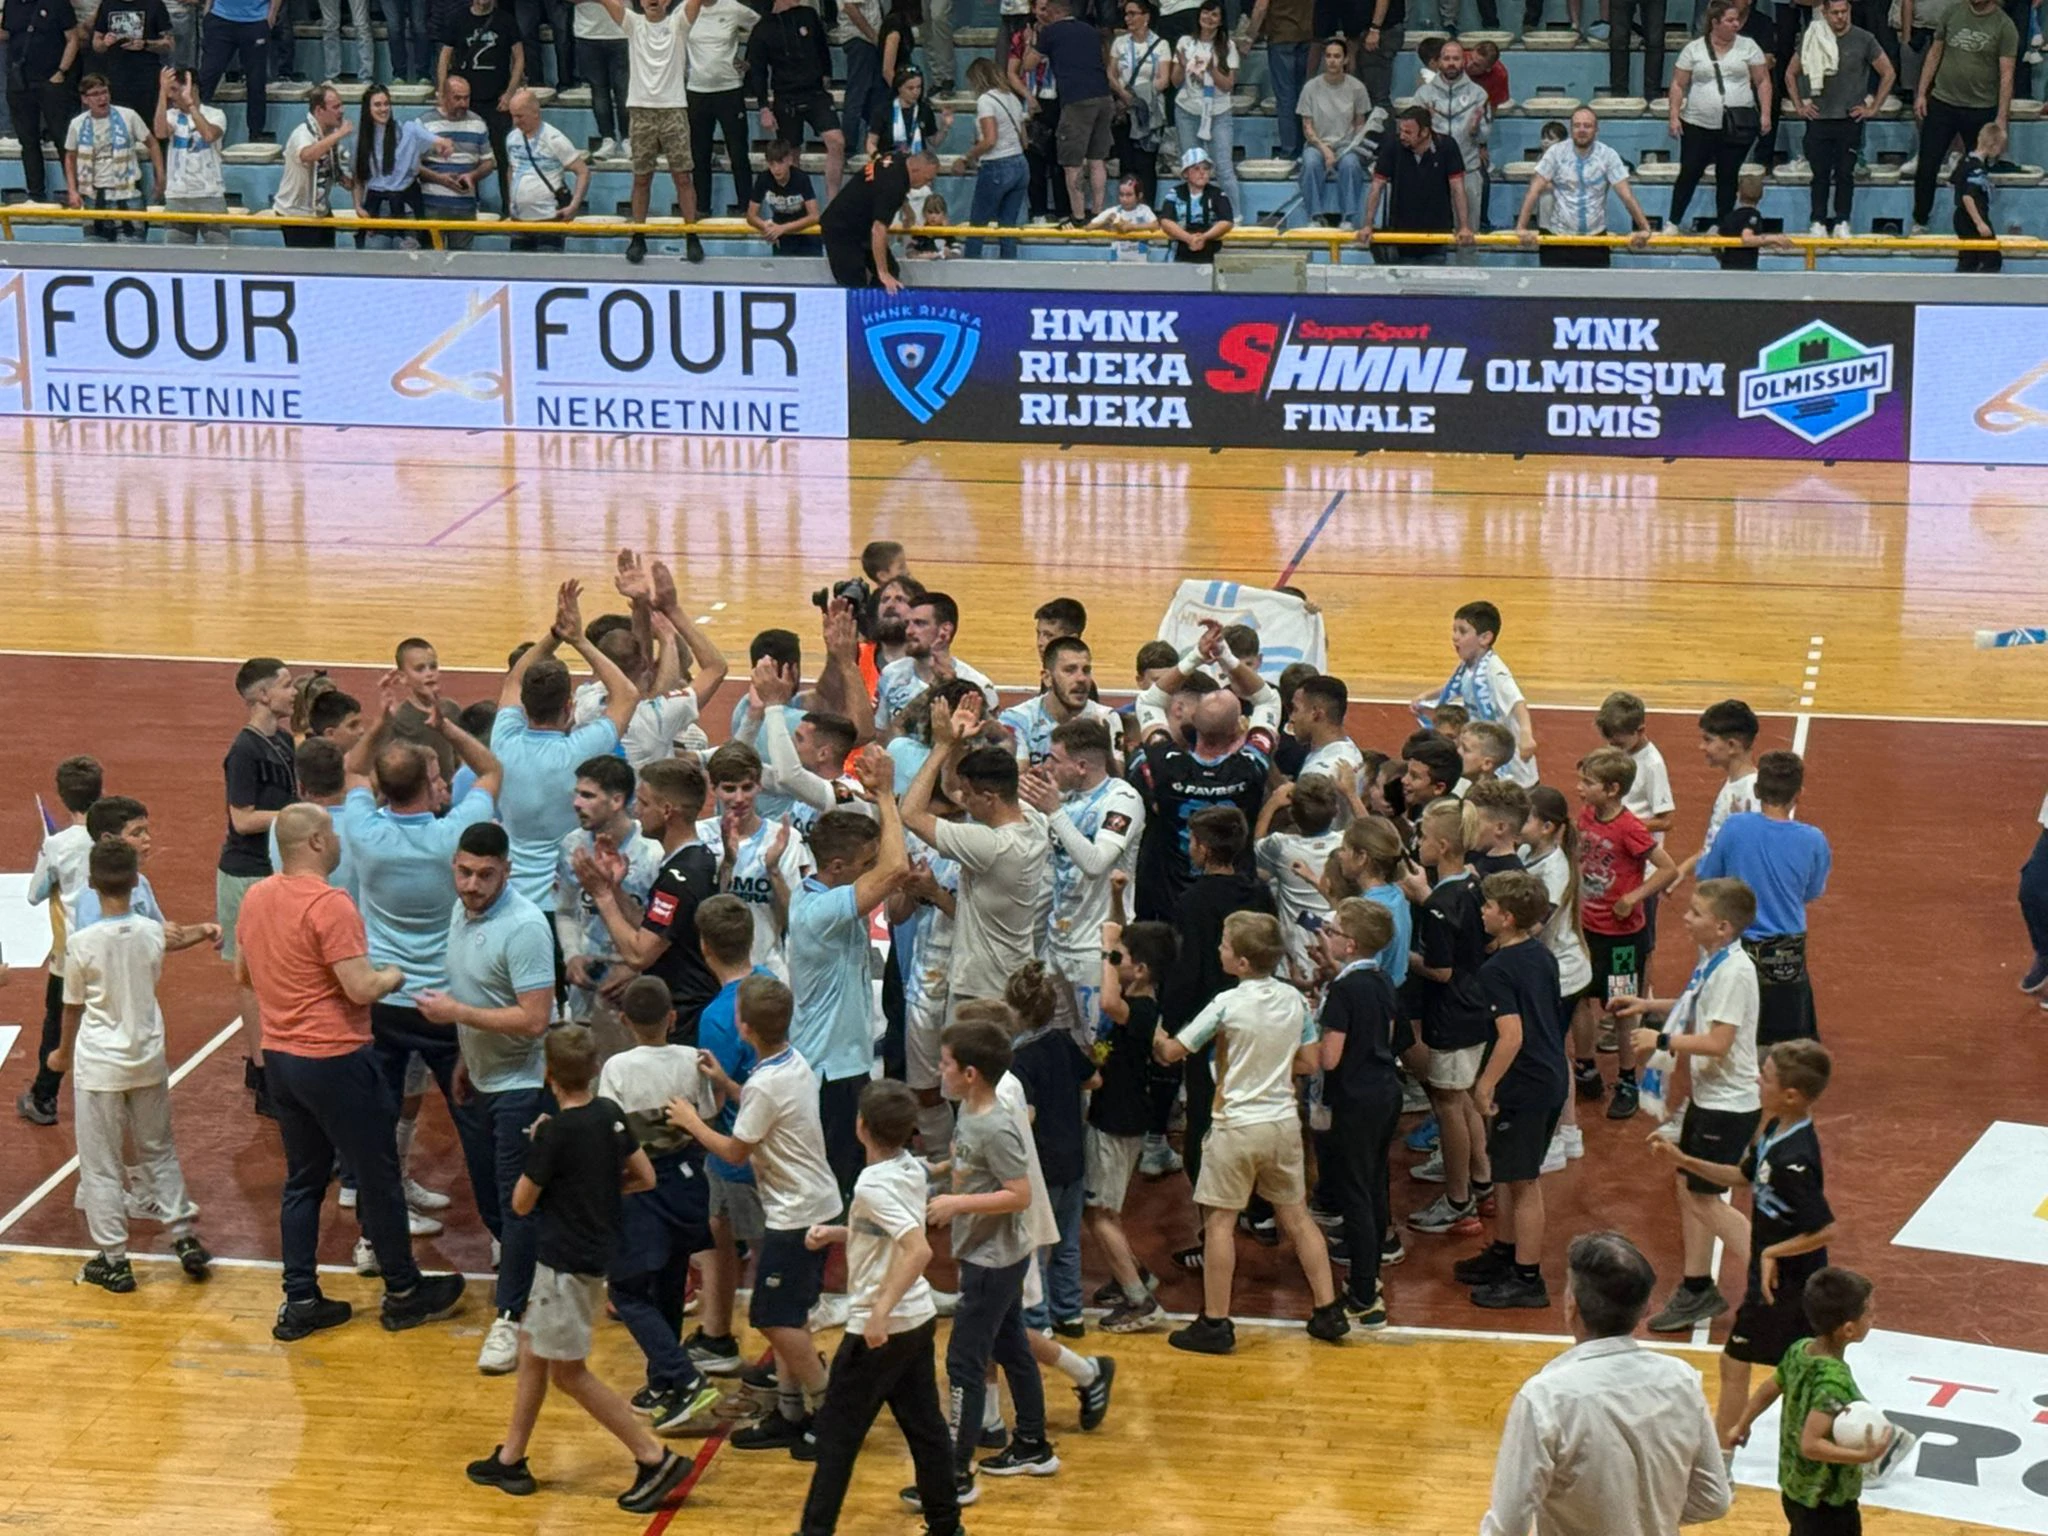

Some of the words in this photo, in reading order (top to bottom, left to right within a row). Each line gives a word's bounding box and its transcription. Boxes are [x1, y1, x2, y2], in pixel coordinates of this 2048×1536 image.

[42, 275, 299, 364] FOUR
[535, 287, 799, 376] FOUR
[861, 304, 912, 326] HMNK
[919, 304, 982, 328] RIJEKA
[1031, 308, 1179, 343] HMNK
[1299, 320, 1431, 341] SuperSport
[1553, 317, 1659, 351] MNK
[1019, 350, 1192, 386] RIJEKA
[1486, 359, 1726, 396] OLMISSUM
[1751, 360, 1880, 402] OLMISSUM
[46, 382, 303, 419] NEKRETNINE
[537, 396, 800, 432] NEKRETNINE
[1019, 393, 1192, 428] RIJEKA
[1283, 404, 1436, 433] FINALE
[1548, 394, 1661, 439] OMIŠ
[727, 876, 772, 894] MO
